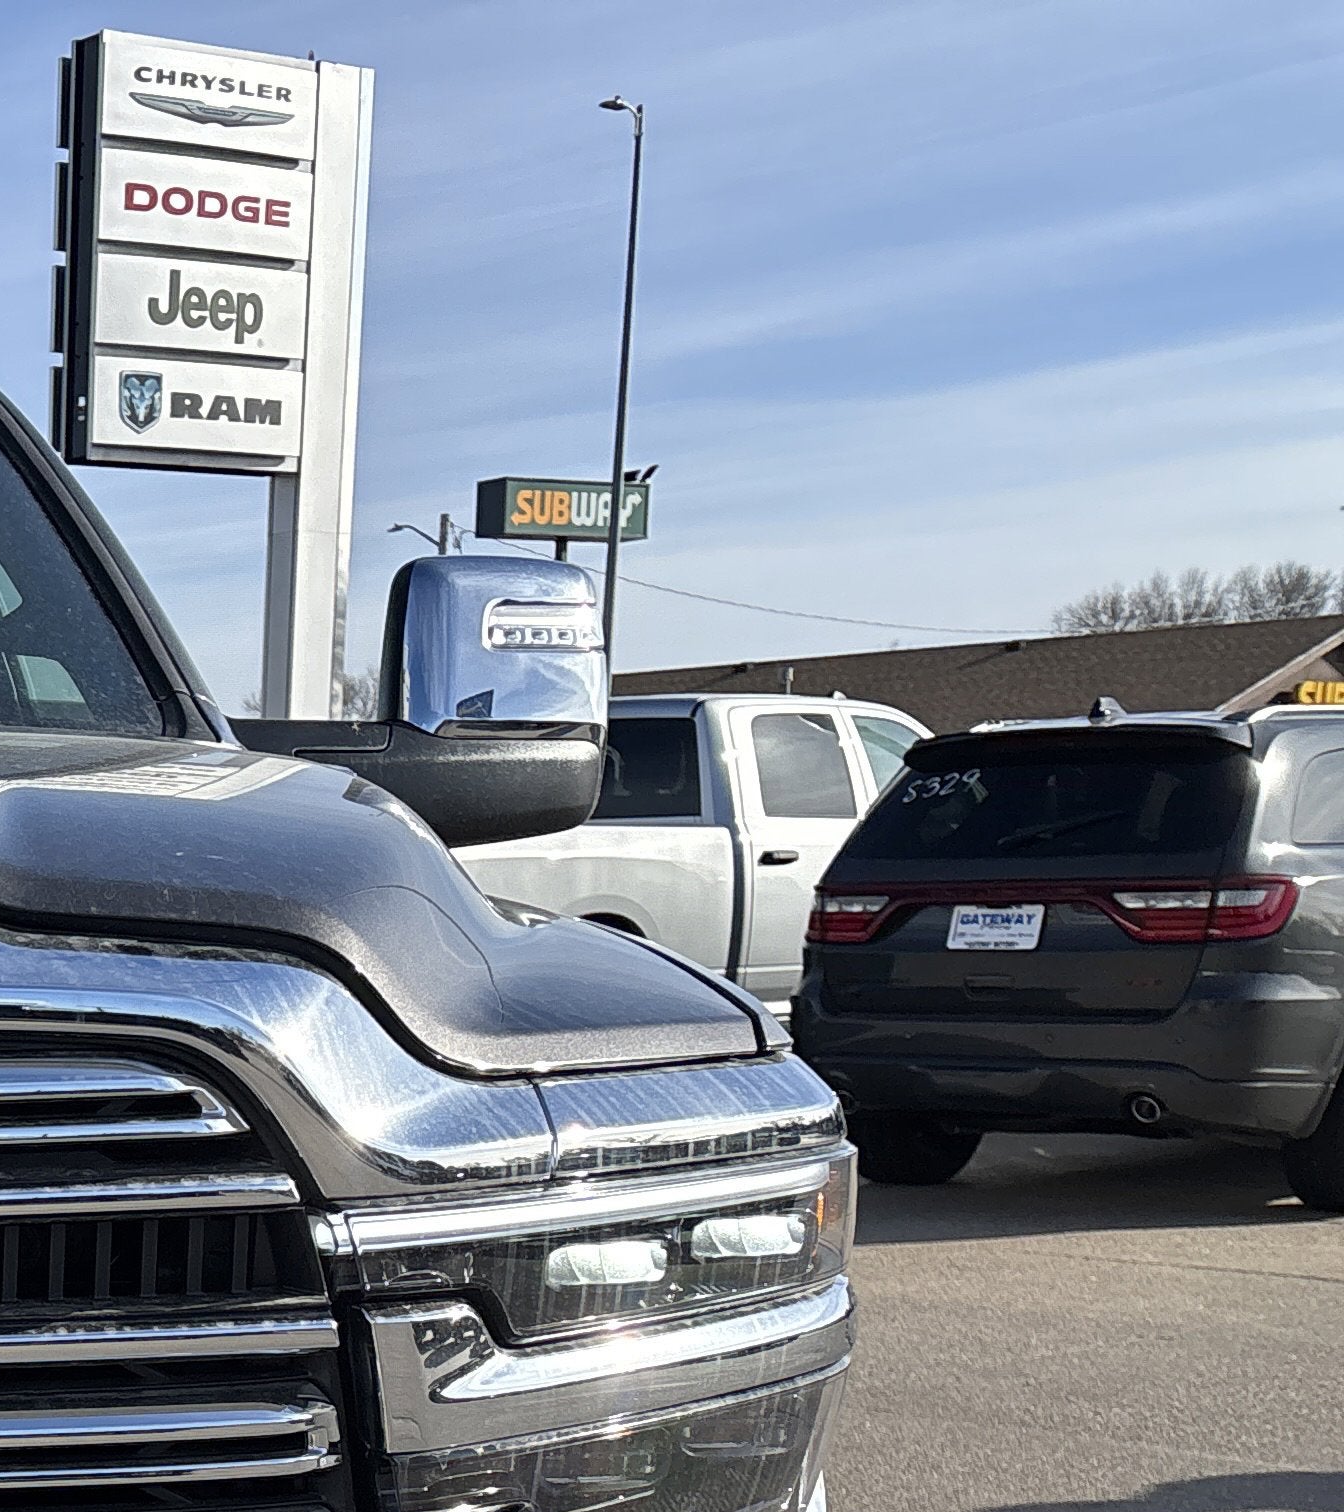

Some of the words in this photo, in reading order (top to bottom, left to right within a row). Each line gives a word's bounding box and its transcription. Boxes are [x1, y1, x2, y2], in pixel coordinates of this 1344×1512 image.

[133, 65, 292, 102] CHRYSLER
[124, 182, 291, 227] DODGE
[147, 269, 264, 344] Jeep
[169, 391, 282, 426] RAM
[511, 489, 643, 527] SUBWAY
[959, 913, 1036, 925] GATEWAY
